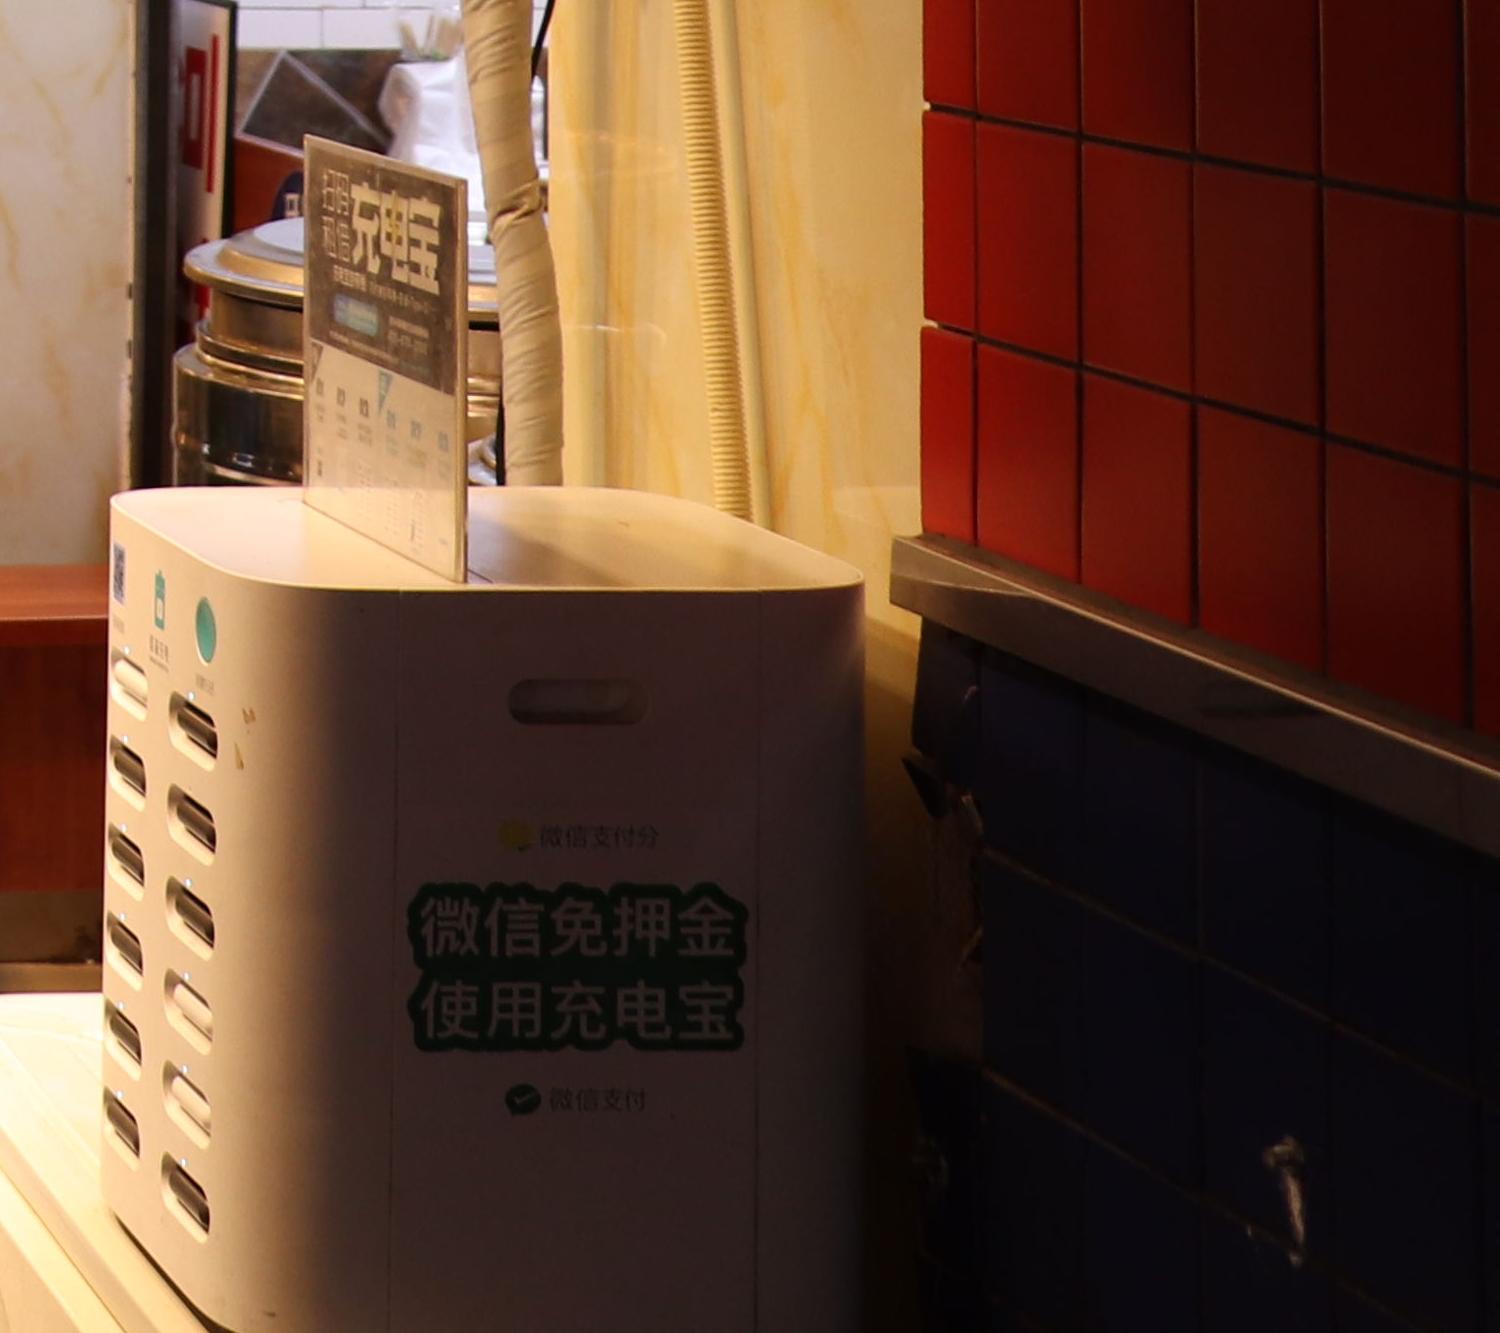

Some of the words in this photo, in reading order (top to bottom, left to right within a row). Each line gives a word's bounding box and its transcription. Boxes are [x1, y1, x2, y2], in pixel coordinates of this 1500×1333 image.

[350, 181, 442, 296] 充电宝
[539, 825, 659, 850] 微信支付分
[420, 895, 736, 958] 微信免押金
[420, 978, 736, 1041] 使用充电宝
[549, 1088, 646, 1112] 微信支付
